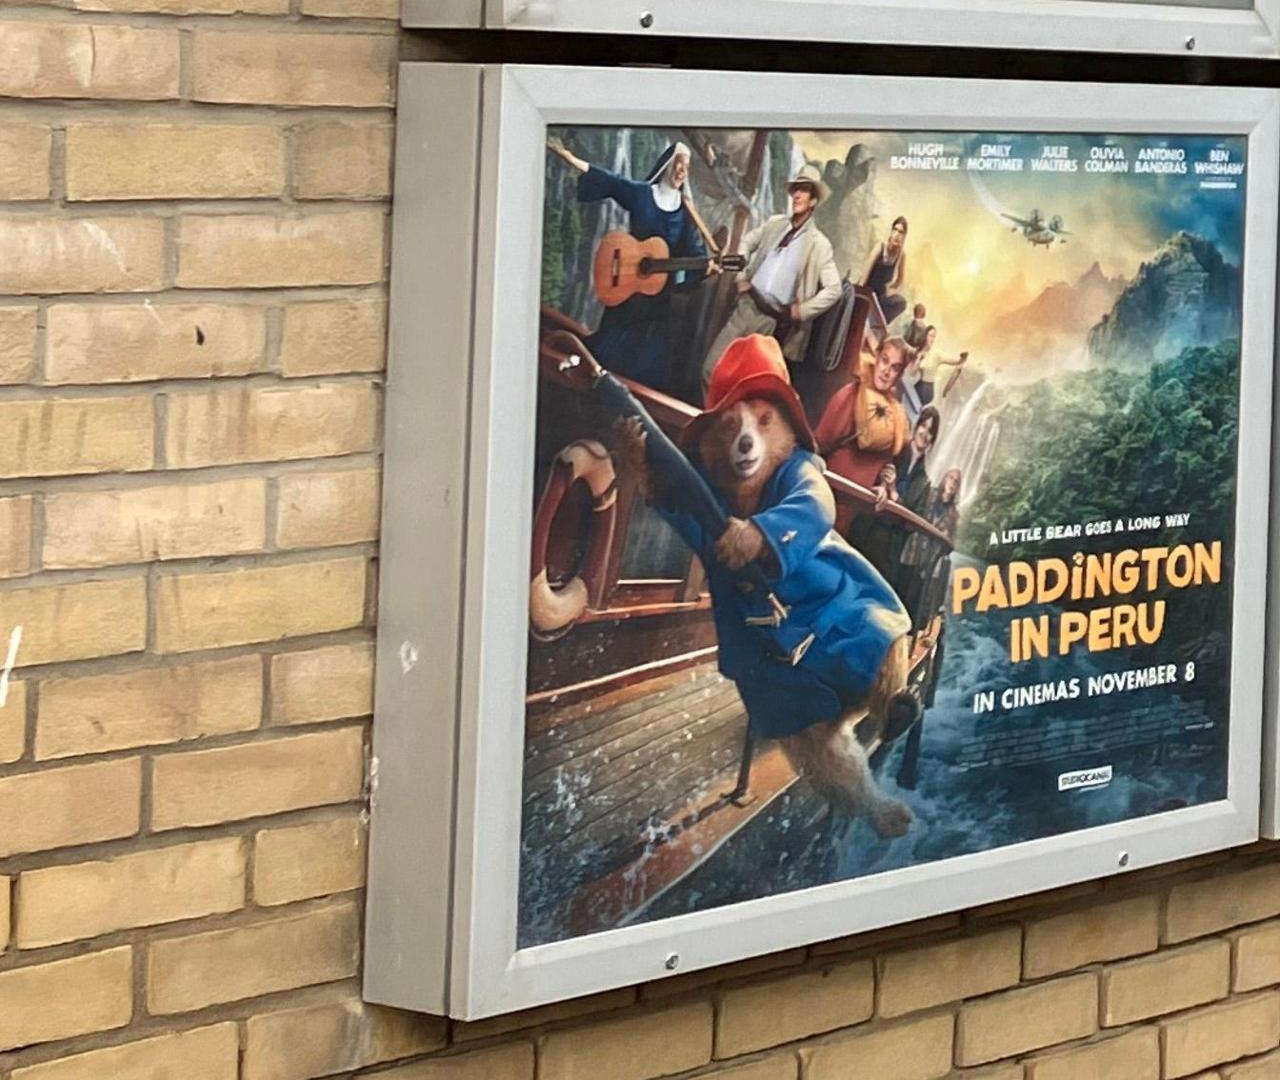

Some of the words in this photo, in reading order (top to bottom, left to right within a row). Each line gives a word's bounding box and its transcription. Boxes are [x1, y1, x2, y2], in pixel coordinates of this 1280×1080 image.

[908, 143, 944, 156] HUGH
[981, 144, 1012, 157] EMILY
[1042, 146, 1069, 158] JULIE
[1090, 147, 1125, 160] OLIVIA
[1138, 148, 1185, 161] ANTONIO
[1209, 150, 1229, 162] BEN
[890, 156, 959, 170] BONNEVILLE
[966, 158, 1024, 171] MORTIMER
[1031, 159, 1078, 172] WALTERS
[1084, 160, 1129, 173] COLMAN
[1134, 161, 1187, 174] BANDERAS
[1194, 162, 1244, 175] WHISHAW
[990, 532, 998, 545] A
[1002, 527, 1041, 544] LITTLE
[1046, 524, 1081, 539] BEAR
[1085, 521, 1112, 536] GOES
[1115, 519, 1124, 532] A
[1128, 516, 1160, 531] LONG
[1165, 513, 1191, 528] WAY
[953, 541, 1221, 615] PADDINGTON
[1010, 615, 1049, 662] IN
[1059, 601, 1166, 655] PERU
[973, 691, 995, 714] IN
[1001, 677, 1081, 709] CINEMAS
[1087, 664, 1176, 697] NOVEMBER
[1184, 662, 1195, 682] 8
